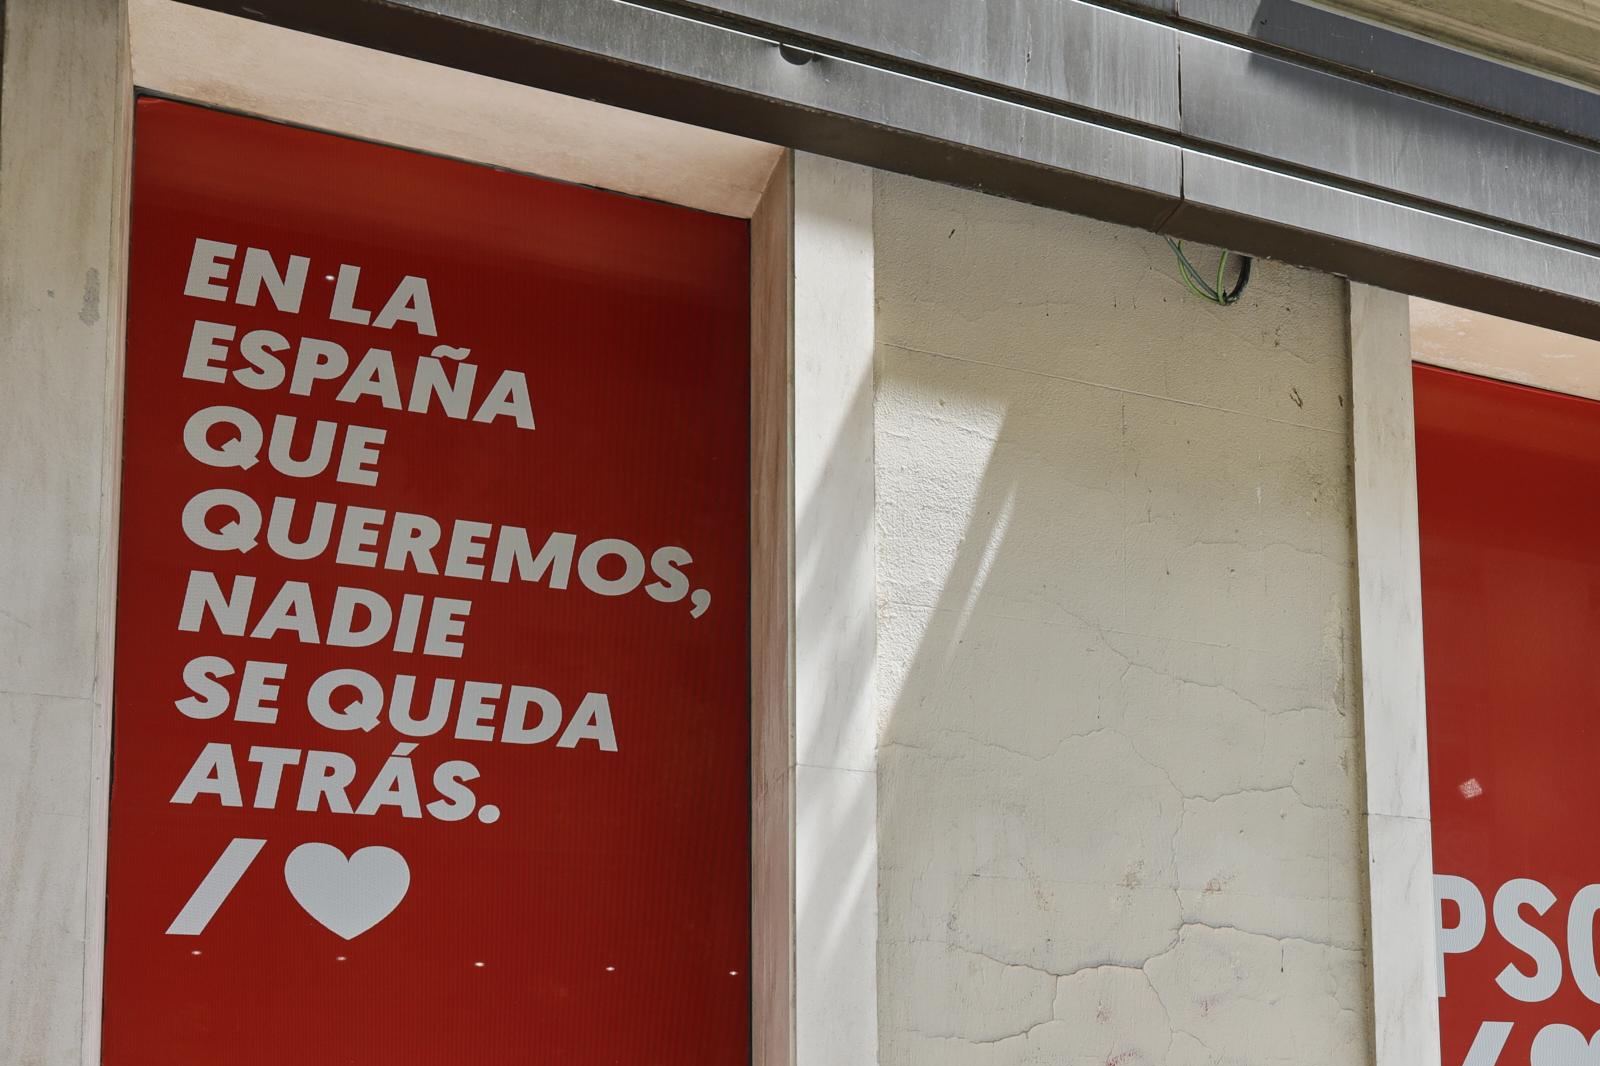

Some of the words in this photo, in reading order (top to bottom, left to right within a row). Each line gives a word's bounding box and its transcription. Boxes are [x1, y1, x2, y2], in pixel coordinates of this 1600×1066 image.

[184, 239, 310, 313] EN
[330, 264, 437, 336] LA
[183, 320, 535, 429] ESPAÑA
[183, 406, 386, 486] QUE
[182, 489, 711, 618] QUEREMOS,
[178, 571, 472, 657] NADIE
[175, 656, 287, 723] SE
[308, 669, 617, 752] QUEDA
[170, 742, 501, 823] ATRÁS.
